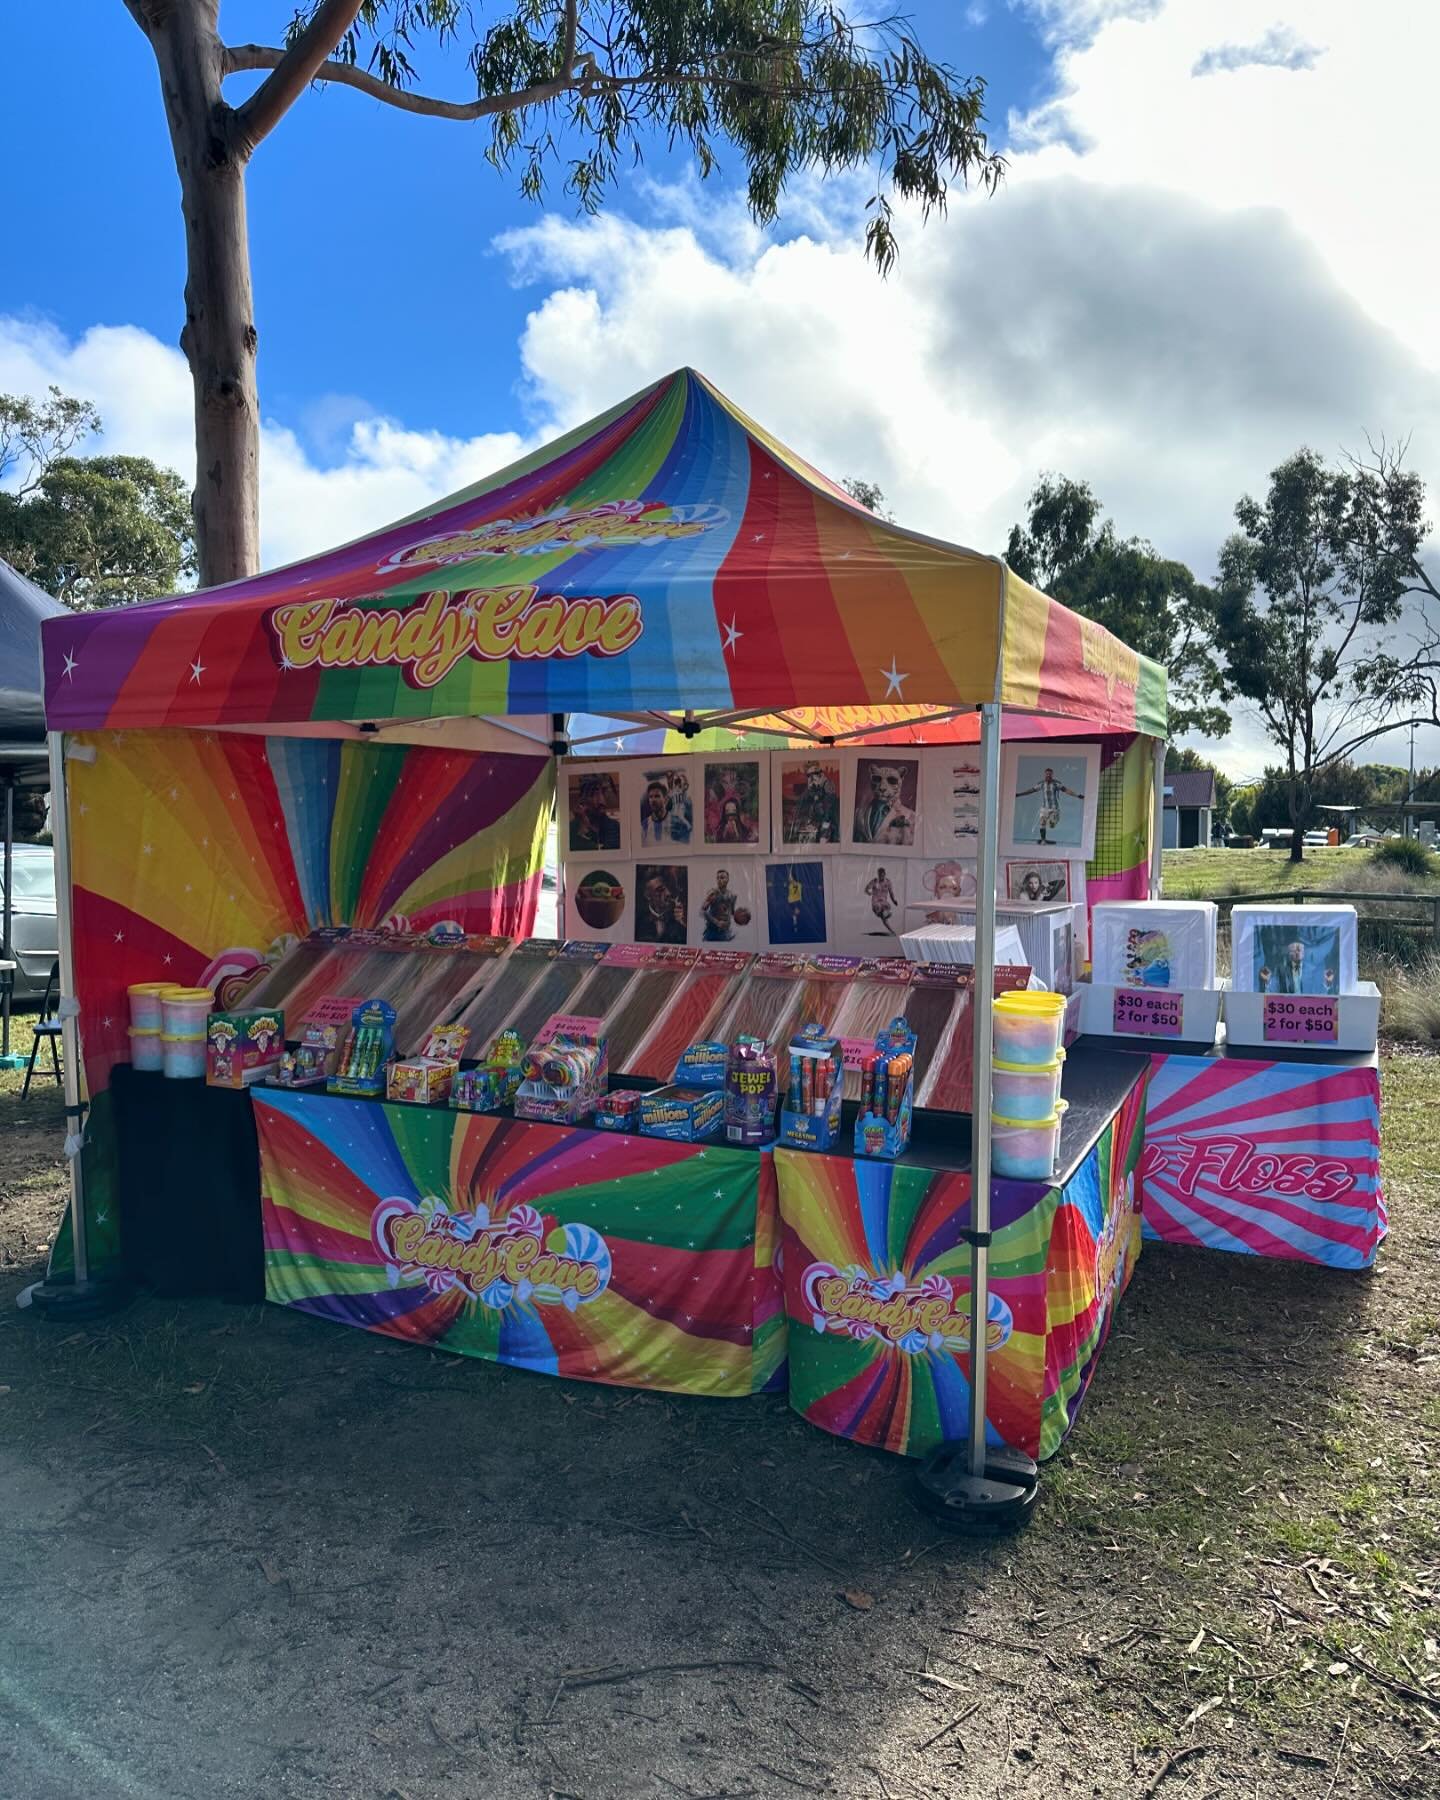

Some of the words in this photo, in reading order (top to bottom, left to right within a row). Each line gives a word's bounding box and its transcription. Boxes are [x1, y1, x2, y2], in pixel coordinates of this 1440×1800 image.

[272, 590, 474, 688] Candy
[464, 585, 643, 660] Cave
[1118, 995, 1143, 1008] $30
[1147, 1000, 1178, 1011] each
[1268, 1001, 1295, 1014] $30
[1299, 1004, 1333, 1016] each
[1117, 1010, 1126, 1020] 2
[1129, 1010, 1148, 1023] for
[1152, 1012, 1178, 1026] $50
[1268, 1018, 1277, 1029] 2
[1280, 1018, 1301, 1030] for
[1305, 1018, 1334, 1033] $50
[731, 1071, 771, 1084] JEWEL
[740, 1084, 765, 1095] POP
[642, 1108, 689, 1124] millions
[1176, 1134, 1355, 1201] Floss
[432, 1213, 457, 1231] The
[391, 1215, 505, 1292] Candy
[500, 1234, 601, 1296] Cave
[852, 1277, 877, 1293] The
[818, 1277, 921, 1339] Candy
[915, 1297, 1003, 1346] Cae
